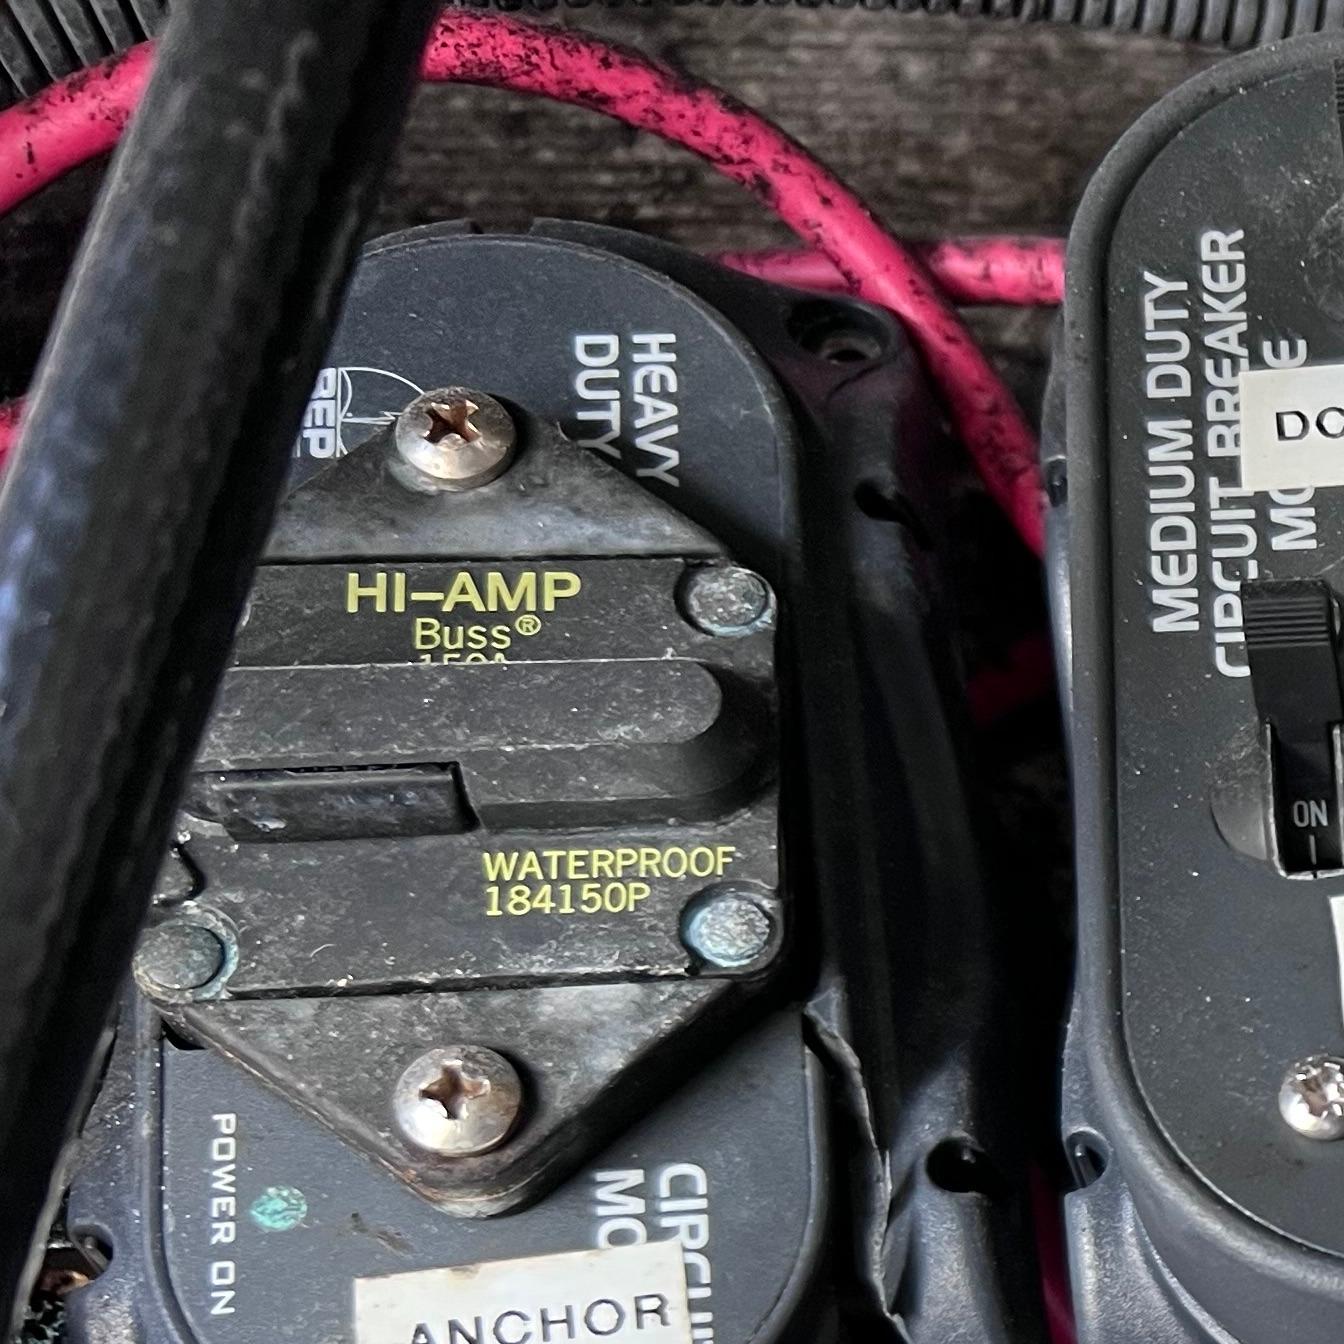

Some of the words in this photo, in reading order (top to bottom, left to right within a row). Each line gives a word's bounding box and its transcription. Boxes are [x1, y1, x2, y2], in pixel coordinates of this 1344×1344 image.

[575, 334, 621, 459] DUTY
[1145, 271, 1191, 398] DUTY
[1201, 228, 1248, 458] BREAKER
[632, 333, 679, 487] HEAVY
[1147, 417, 1200, 633] MEDIUM
[346, 571, 582, 614] HI-AMP
[483, 847, 736, 883] WATERPROOF
[1293, 799, 1328, 828] ON
[484, 884, 651, 918] 184150P
[210, 1112, 237, 1247] POWER
[209, 1262, 236, 1316] ON
